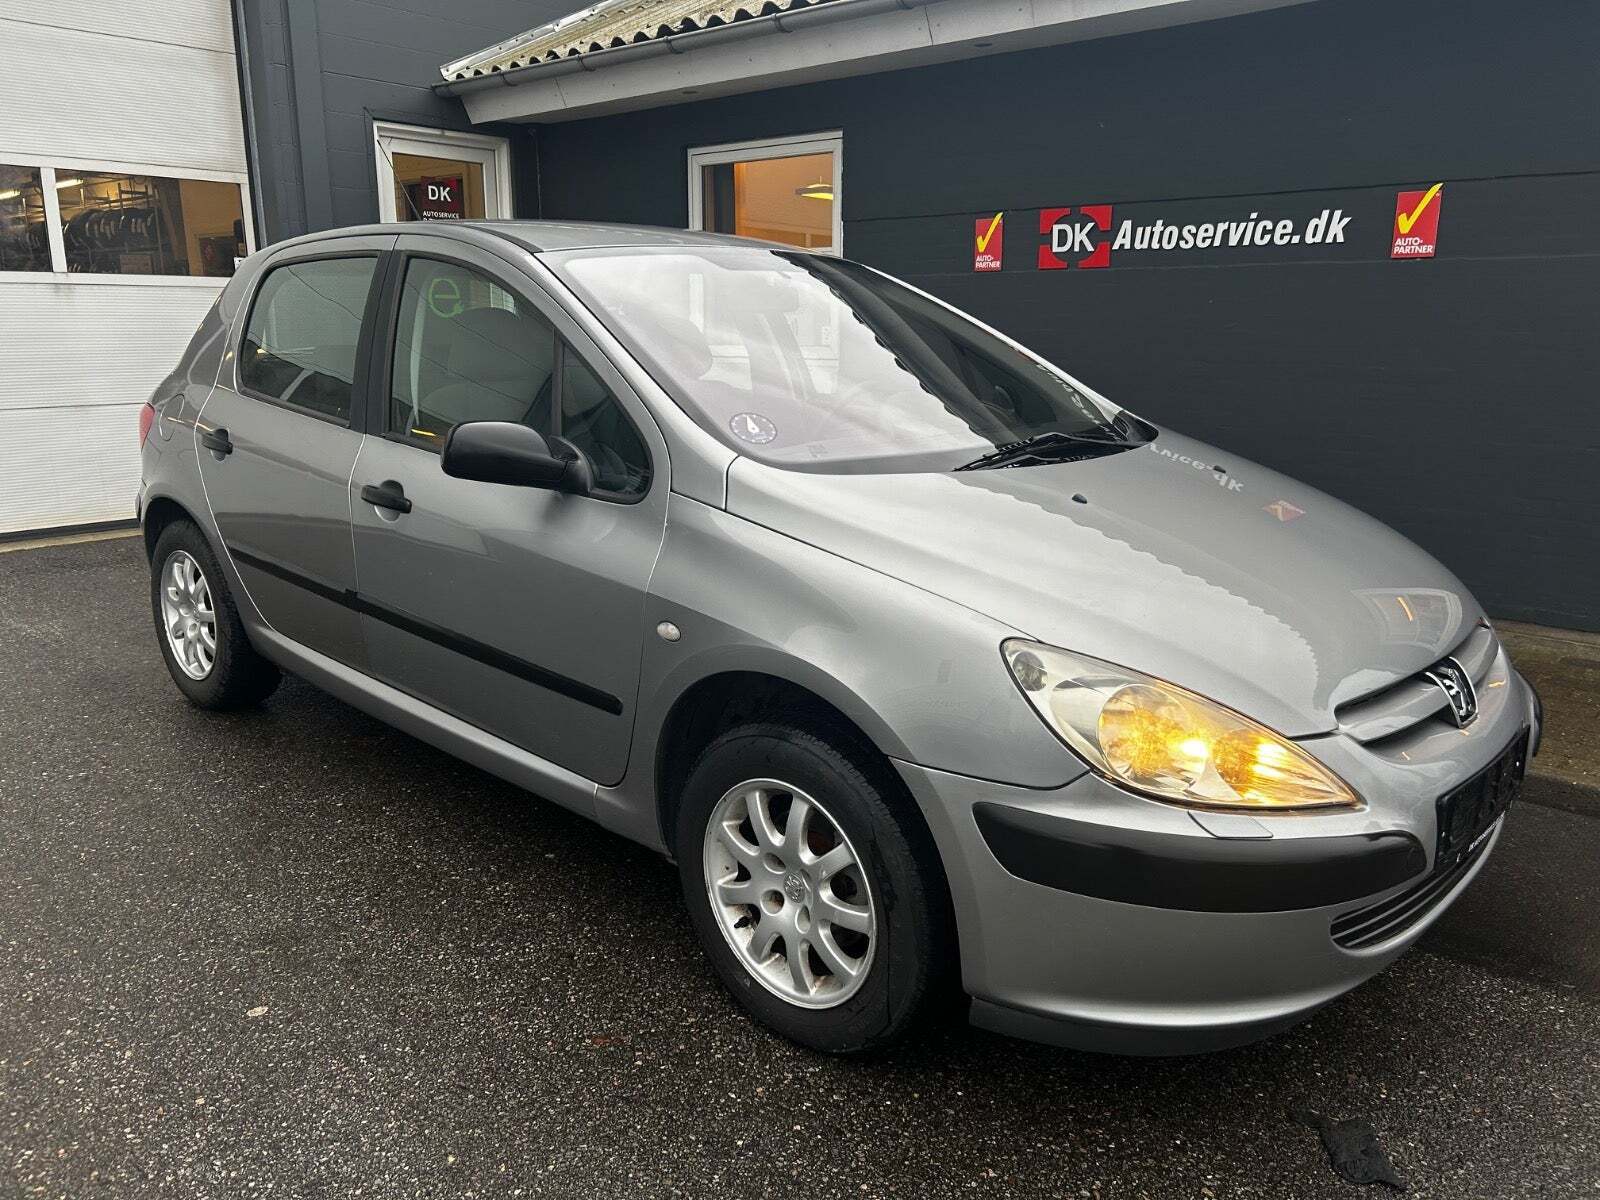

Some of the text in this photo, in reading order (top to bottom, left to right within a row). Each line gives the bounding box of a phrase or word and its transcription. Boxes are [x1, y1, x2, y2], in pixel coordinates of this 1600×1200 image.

[427, 185, 452, 202] DK
[1052, 209, 1352, 253] DK Autoservice.dk
[1393, 245, 1434, 254] PARTNER
[975, 260, 1000, 268] PARTNER
